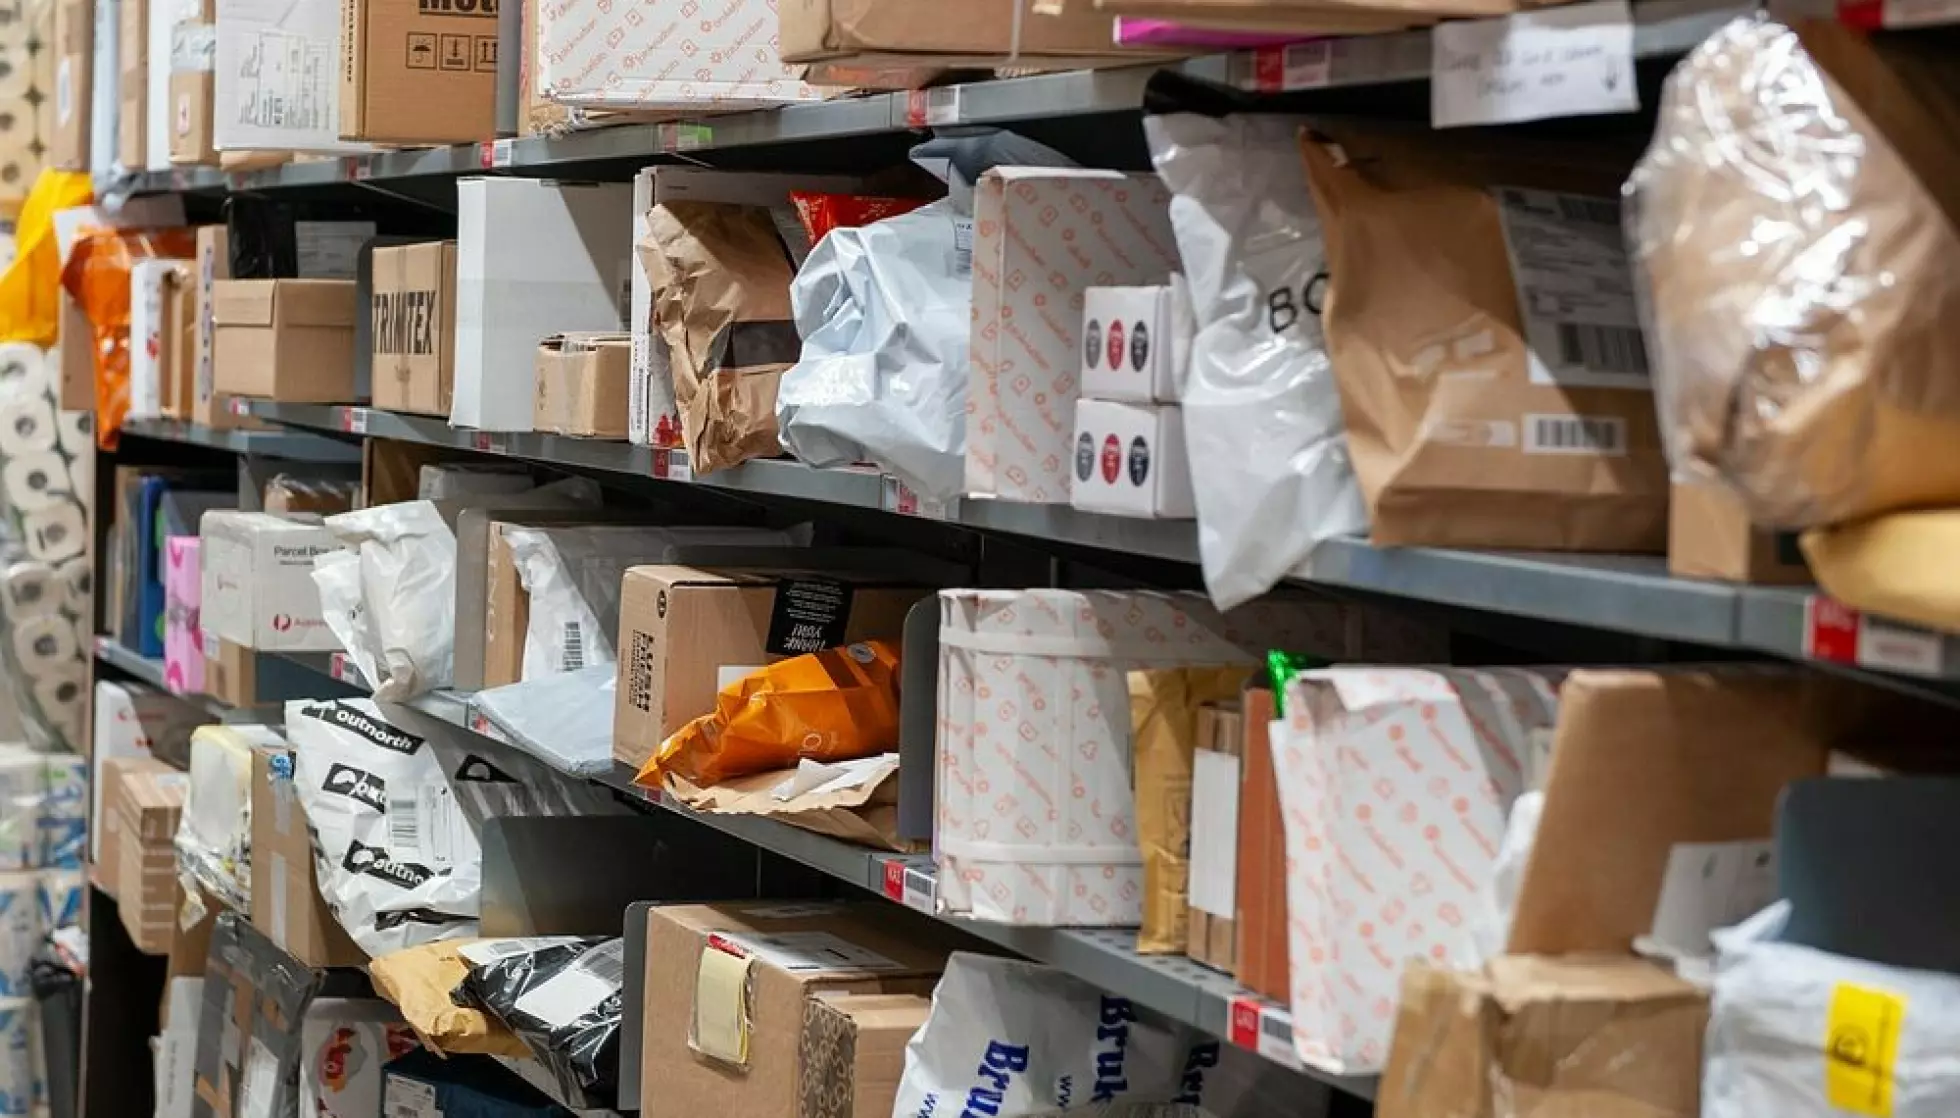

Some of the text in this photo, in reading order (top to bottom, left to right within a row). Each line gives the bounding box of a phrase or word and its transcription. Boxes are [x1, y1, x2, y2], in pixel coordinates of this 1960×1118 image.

[274, 544, 306, 557] Parcel
[336, 709, 412, 750] outnorth
[960, 1039, 1029, 1118] Bru
